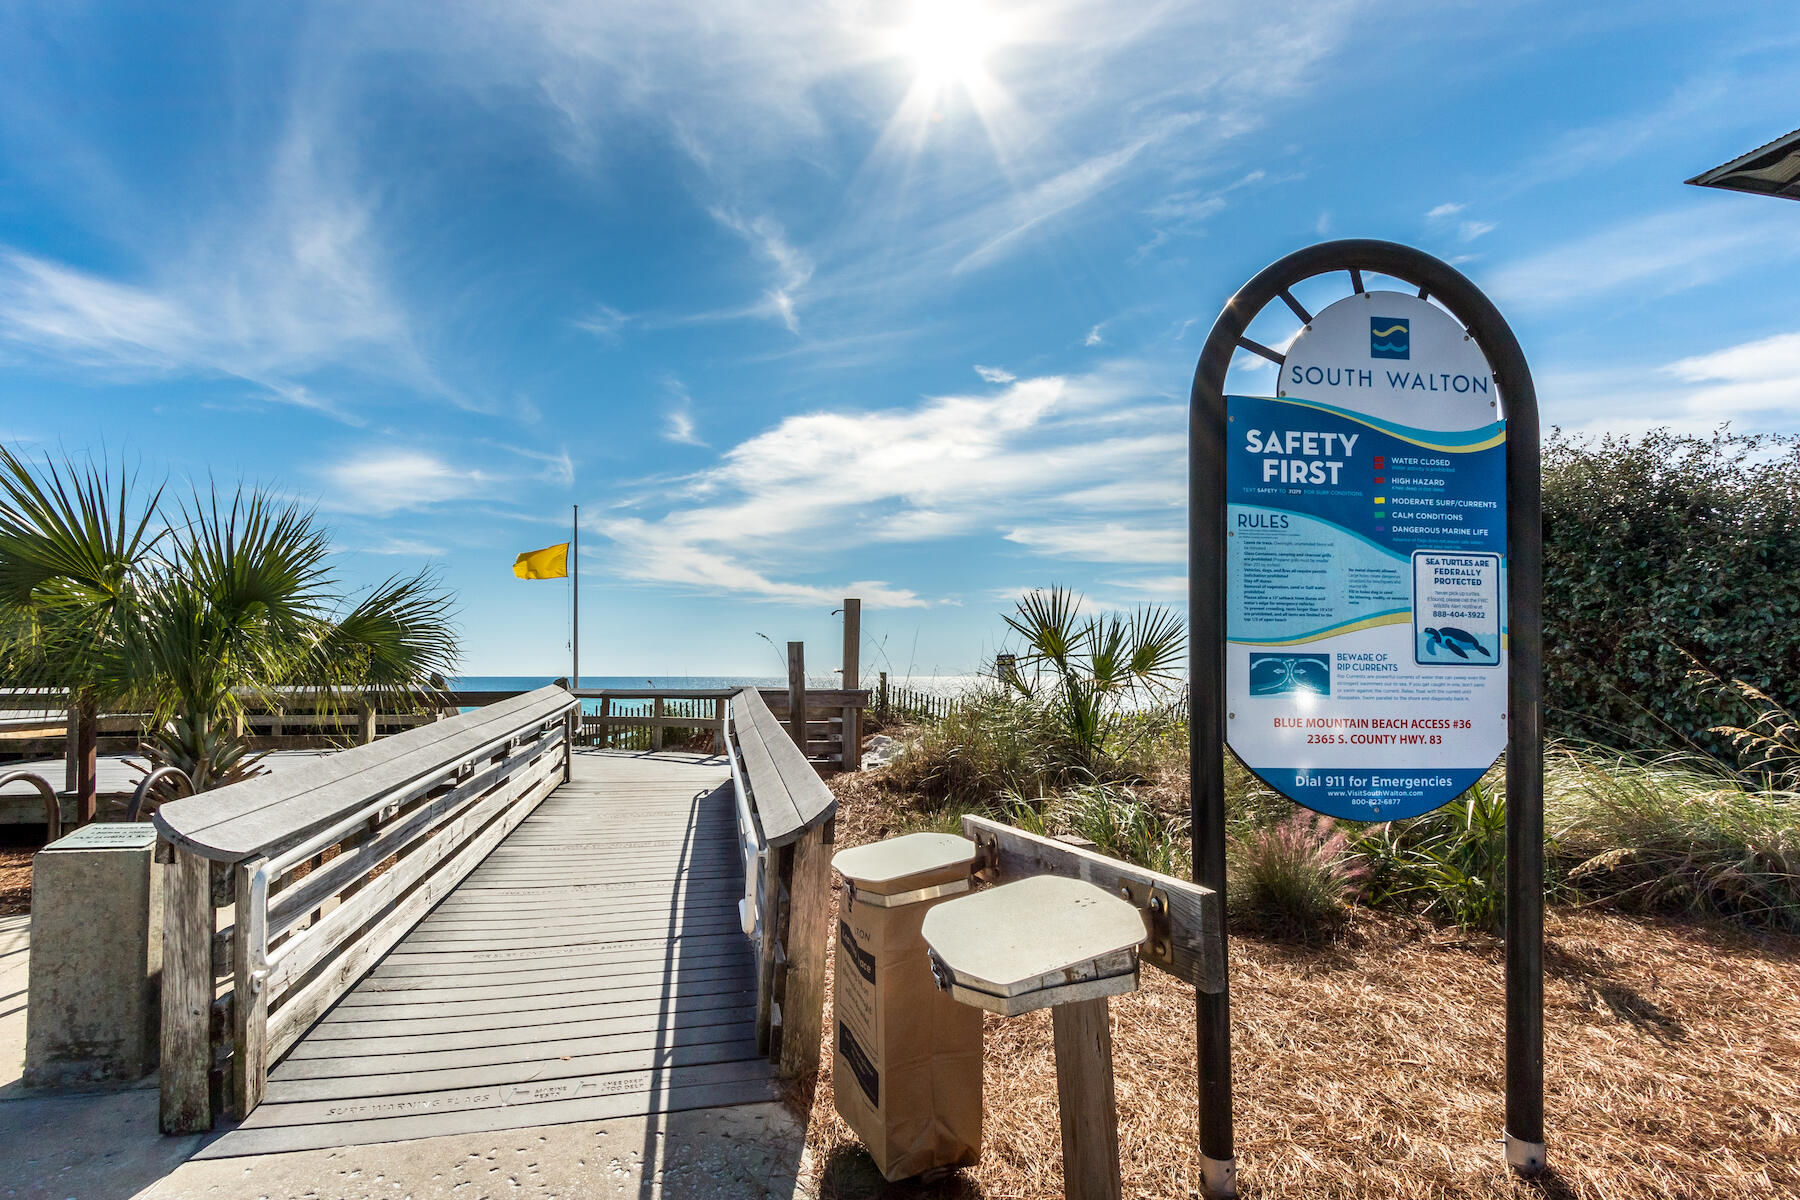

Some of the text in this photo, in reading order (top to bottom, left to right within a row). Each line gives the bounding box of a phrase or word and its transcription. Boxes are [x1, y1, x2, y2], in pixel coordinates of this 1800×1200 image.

[1292, 366, 1488, 393] SOUTH WALTON
[1245, 429, 1359, 456] SAFETY
[1263, 459, 1343, 484] FIRST
[1413, 478, 1445, 486] HAZARD
[1392, 498, 1497, 508] MODERATE SURF/CURRENTS
[1238, 514, 1289, 528] RULES
[1416, 512, 1463, 521] CONDITIONS
[1392, 526, 1440, 534] DANGEROUS
[1442, 527, 1471, 535] MARINE
[1441, 559, 1473, 567] TURTLES
[1434, 568, 1481, 576] FEDERALLY
[1434, 578, 1482, 586] PROTECTED
[1337, 653, 1373, 661] BEWARE
[1352, 664, 1398, 672] CURRENTS
[1274, 718, 1471, 729] BLUE MOUNTAIN BEACH ACCESS #36
[1307, 734, 1442, 744] 2365 S. COUNTY HWY. 83
[1295, 776, 1452, 789] Dial 911 for Emergencies
